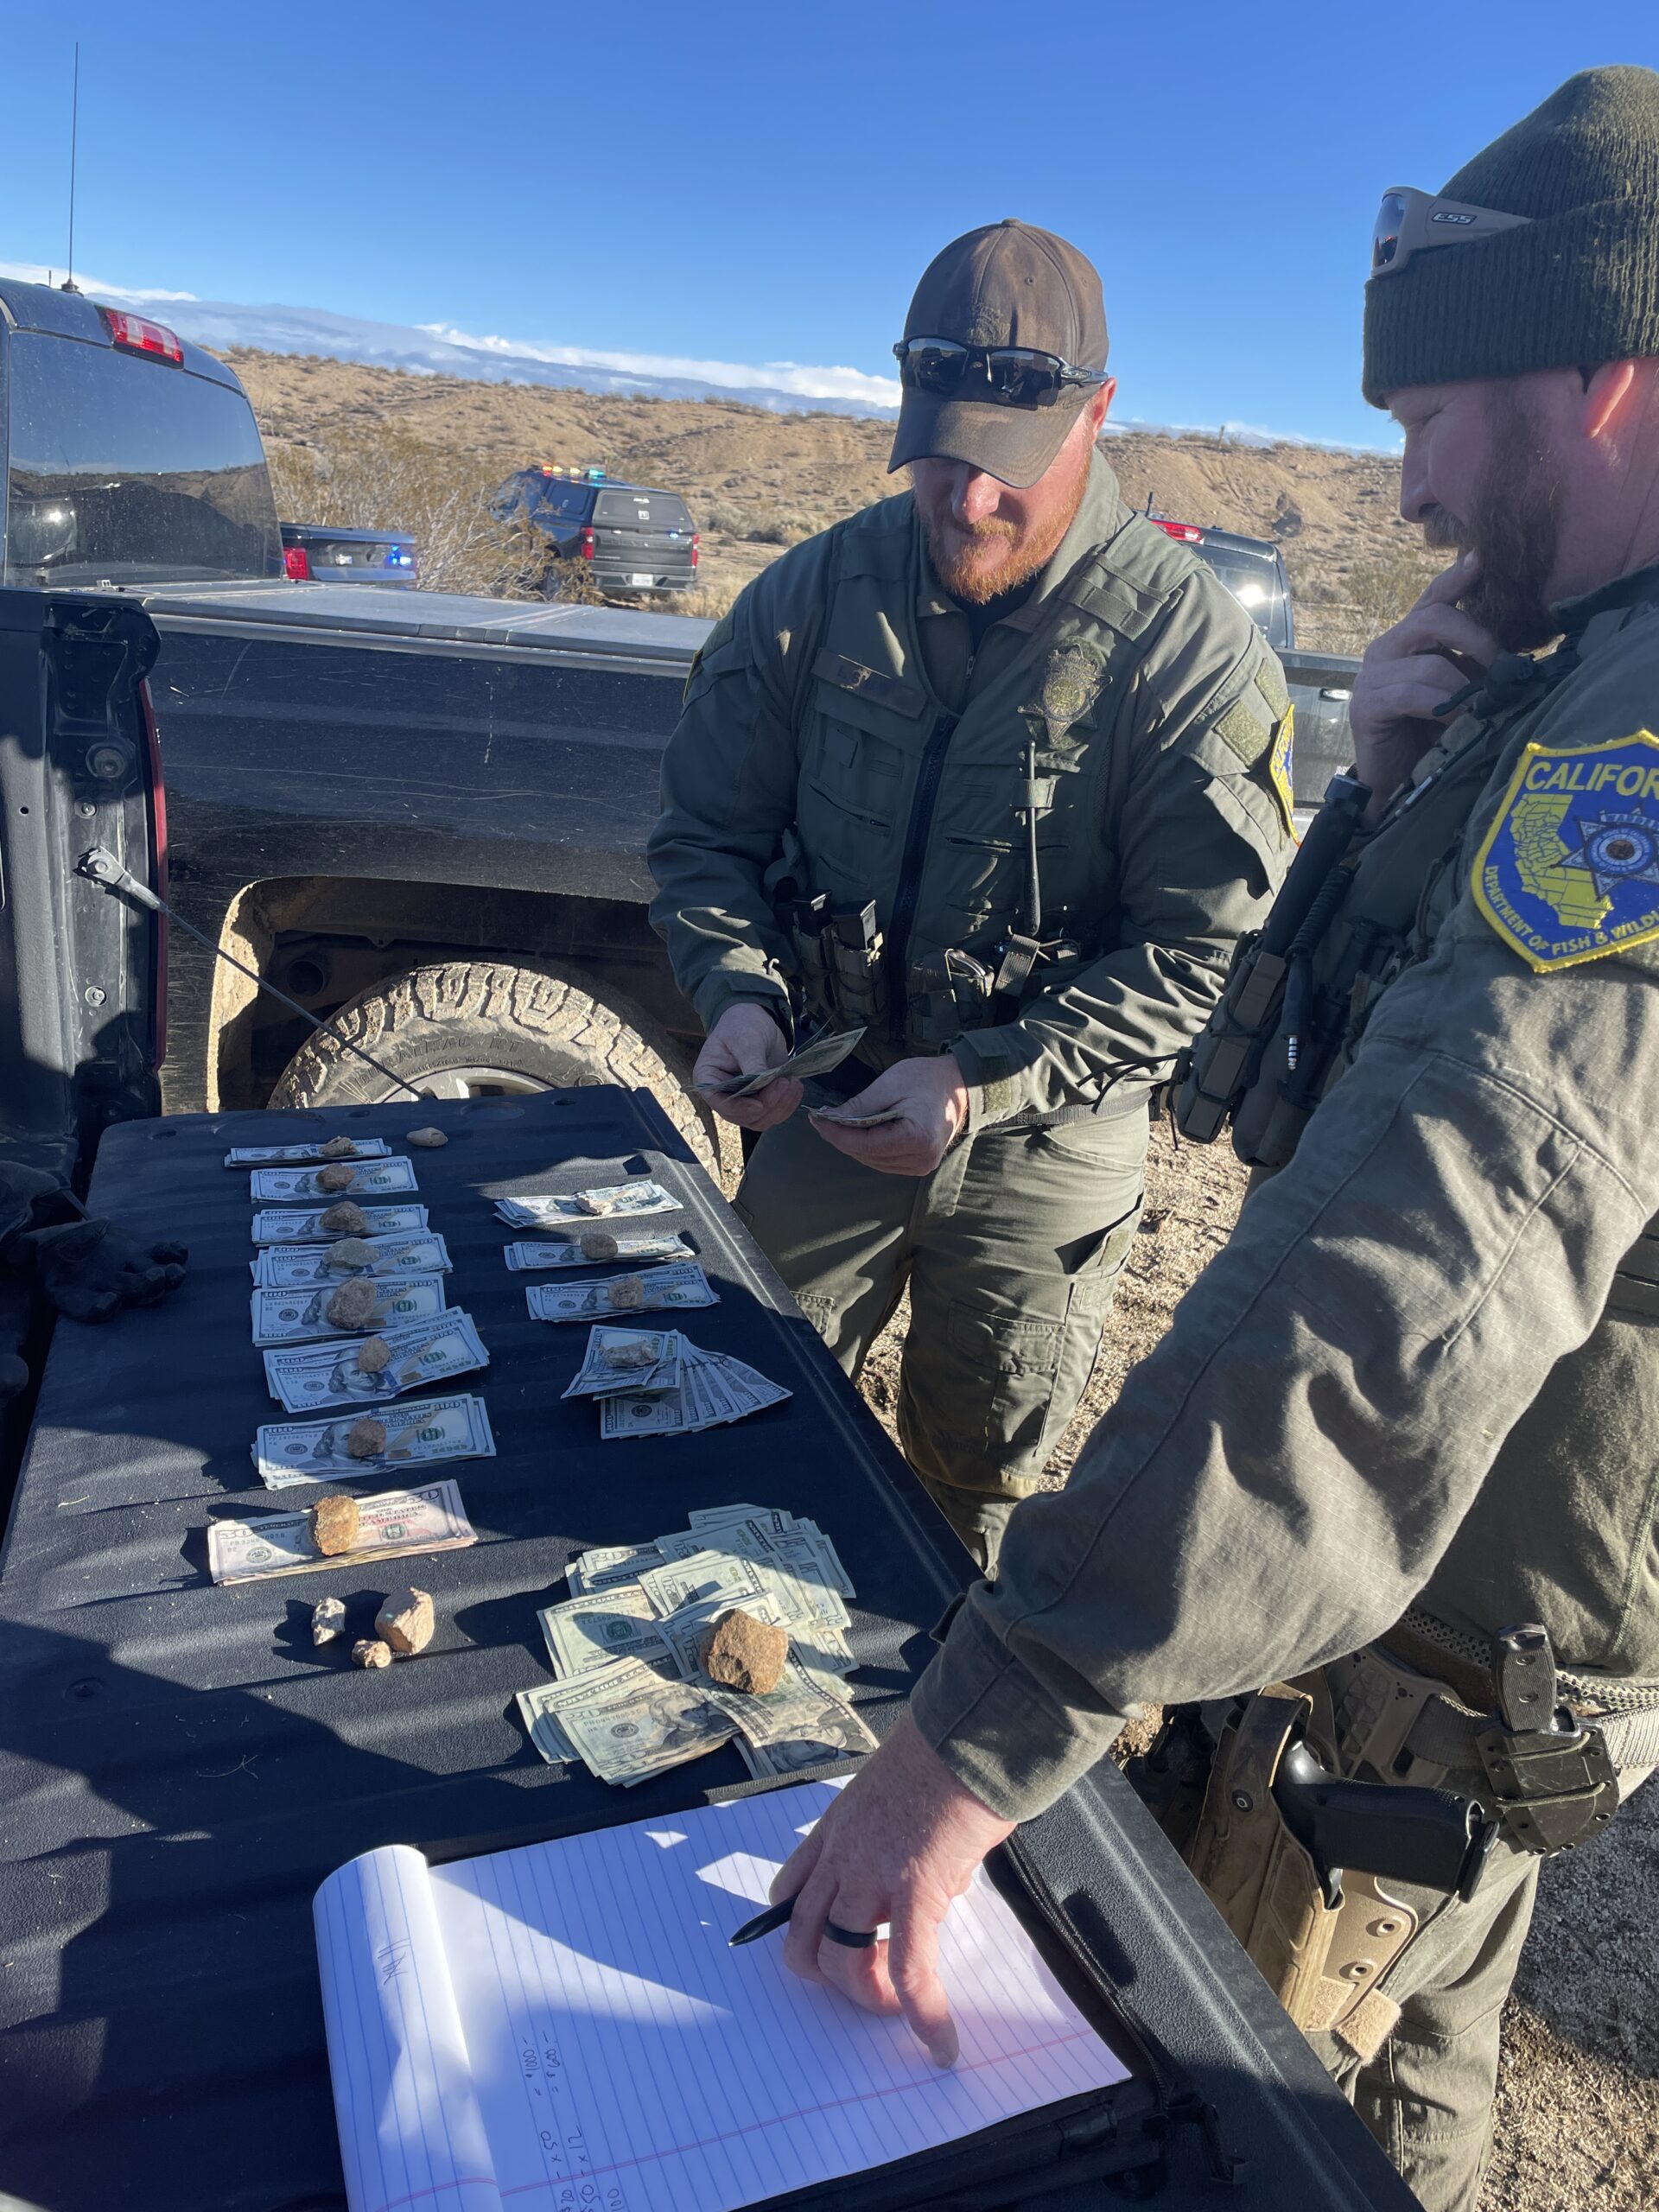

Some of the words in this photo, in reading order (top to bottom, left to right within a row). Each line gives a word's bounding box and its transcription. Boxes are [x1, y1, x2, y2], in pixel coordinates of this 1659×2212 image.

[1433, 213, 1472, 225] ESS
[1484, 865, 1534, 938] DEPARTMENT
[1551, 936, 1591, 956] FISH
[1594, 931, 1609, 945] &
[540, 2130, 558, 2151] 50
